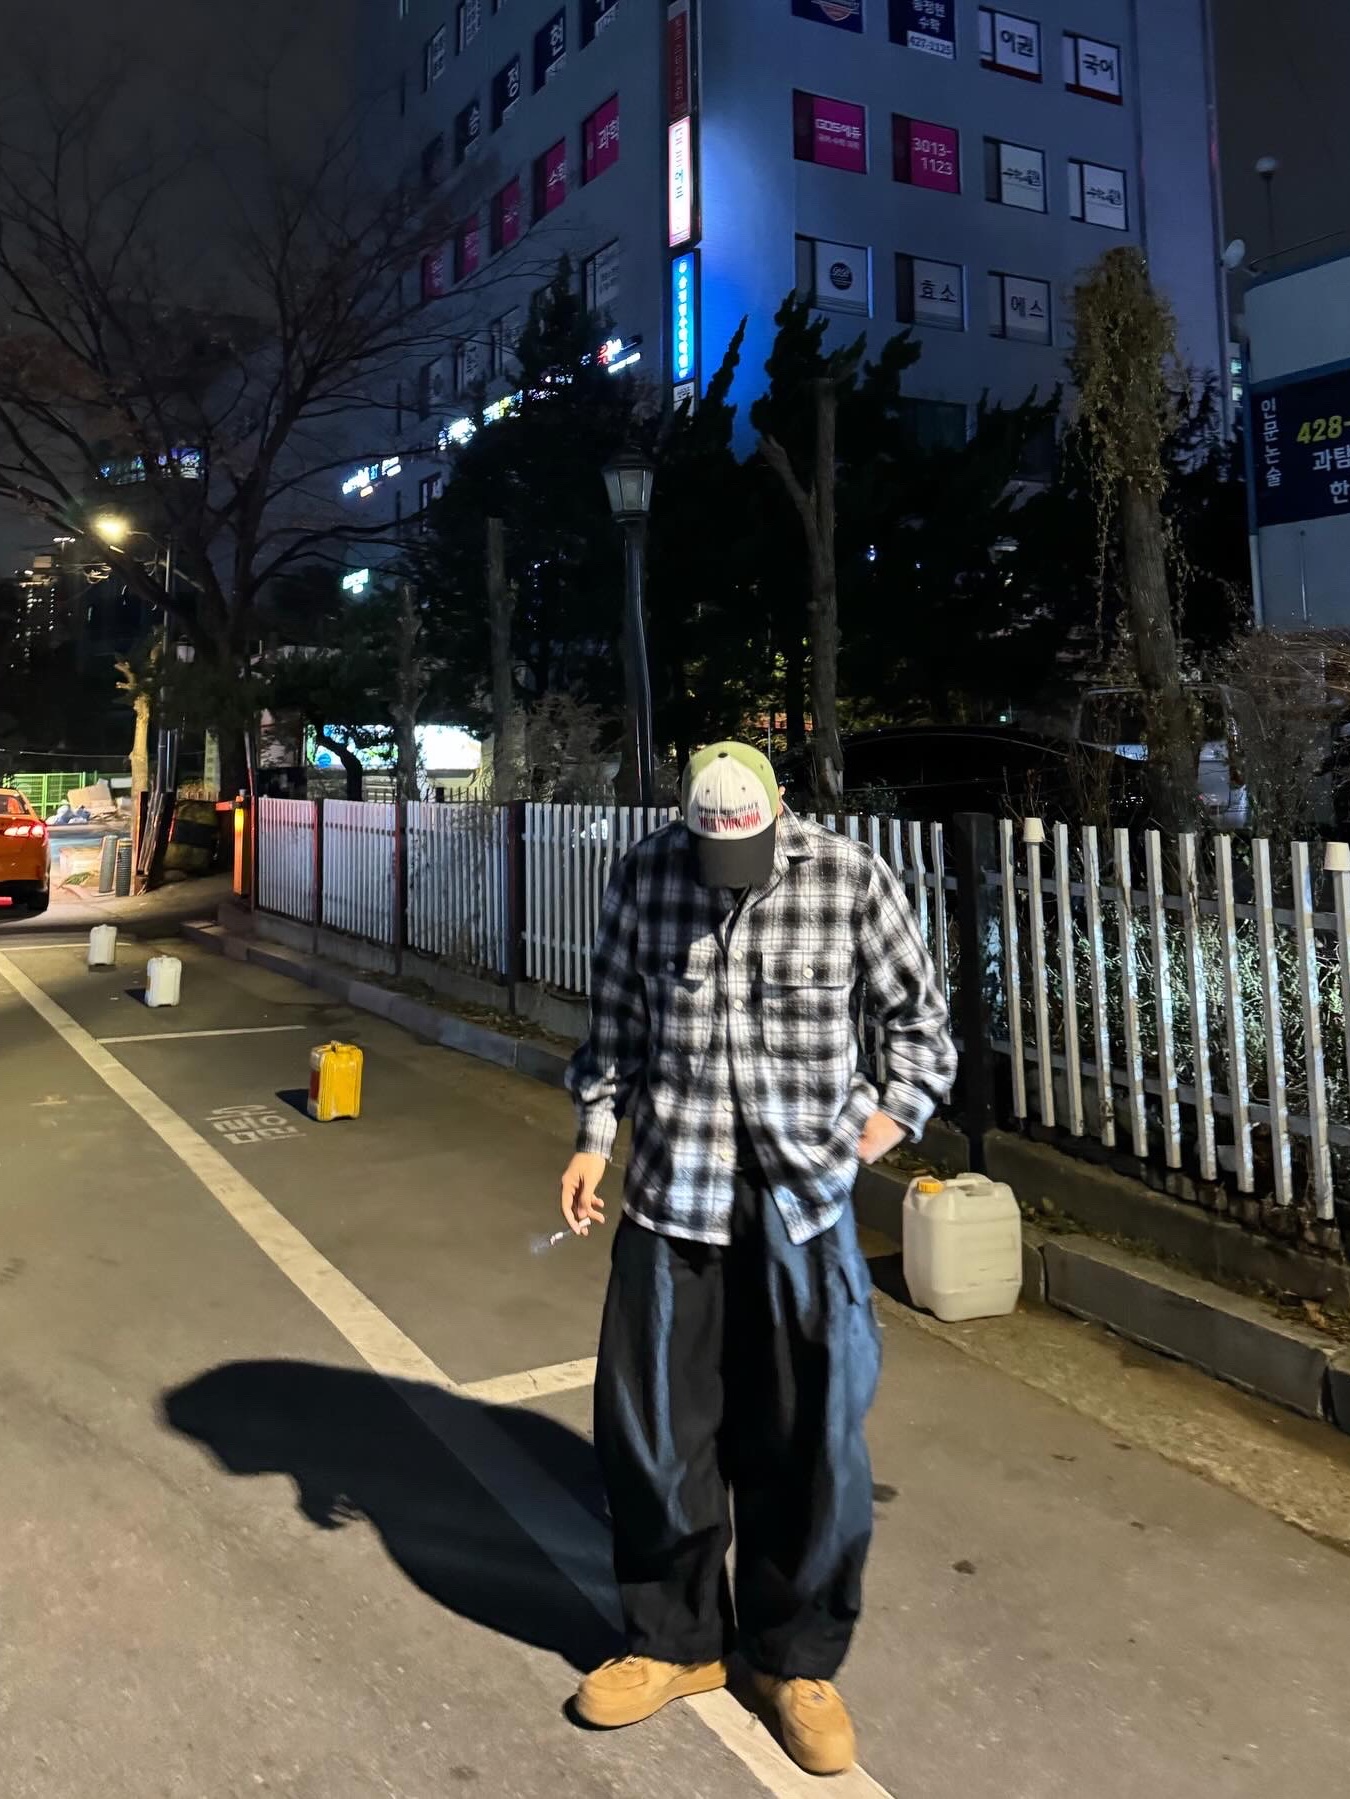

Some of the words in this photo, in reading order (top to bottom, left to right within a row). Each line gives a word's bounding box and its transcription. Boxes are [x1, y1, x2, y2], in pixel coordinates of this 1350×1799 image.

[1083, 52, 1115, 82] 국어
[920, 156, 953, 176] 1123
[919, 279, 956, 304] 효소
[1260, 397, 1282, 488] 인문논술
[721, 810, 761, 831] VIRGINIA
